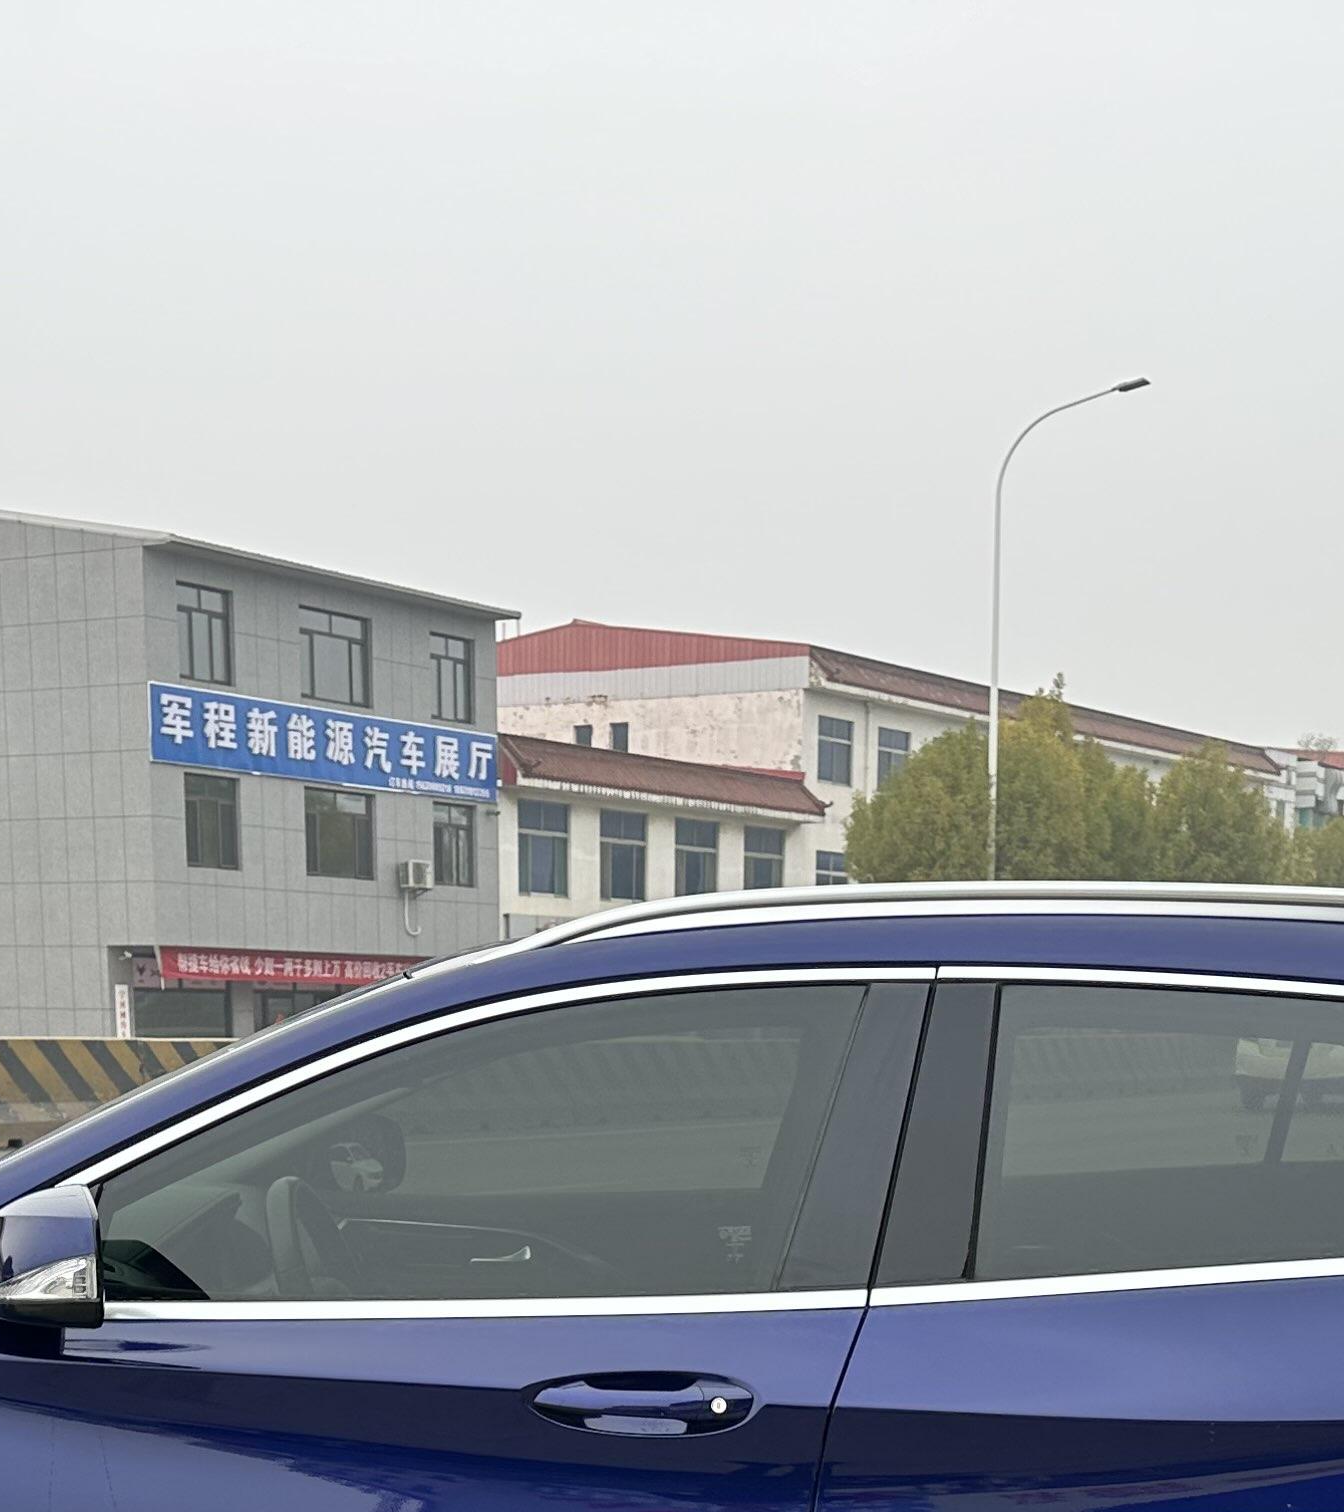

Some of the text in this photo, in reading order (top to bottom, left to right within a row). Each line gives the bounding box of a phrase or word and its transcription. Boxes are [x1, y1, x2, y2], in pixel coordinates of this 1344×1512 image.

[159, 693, 494, 782] 军程新能源汽车展厅
